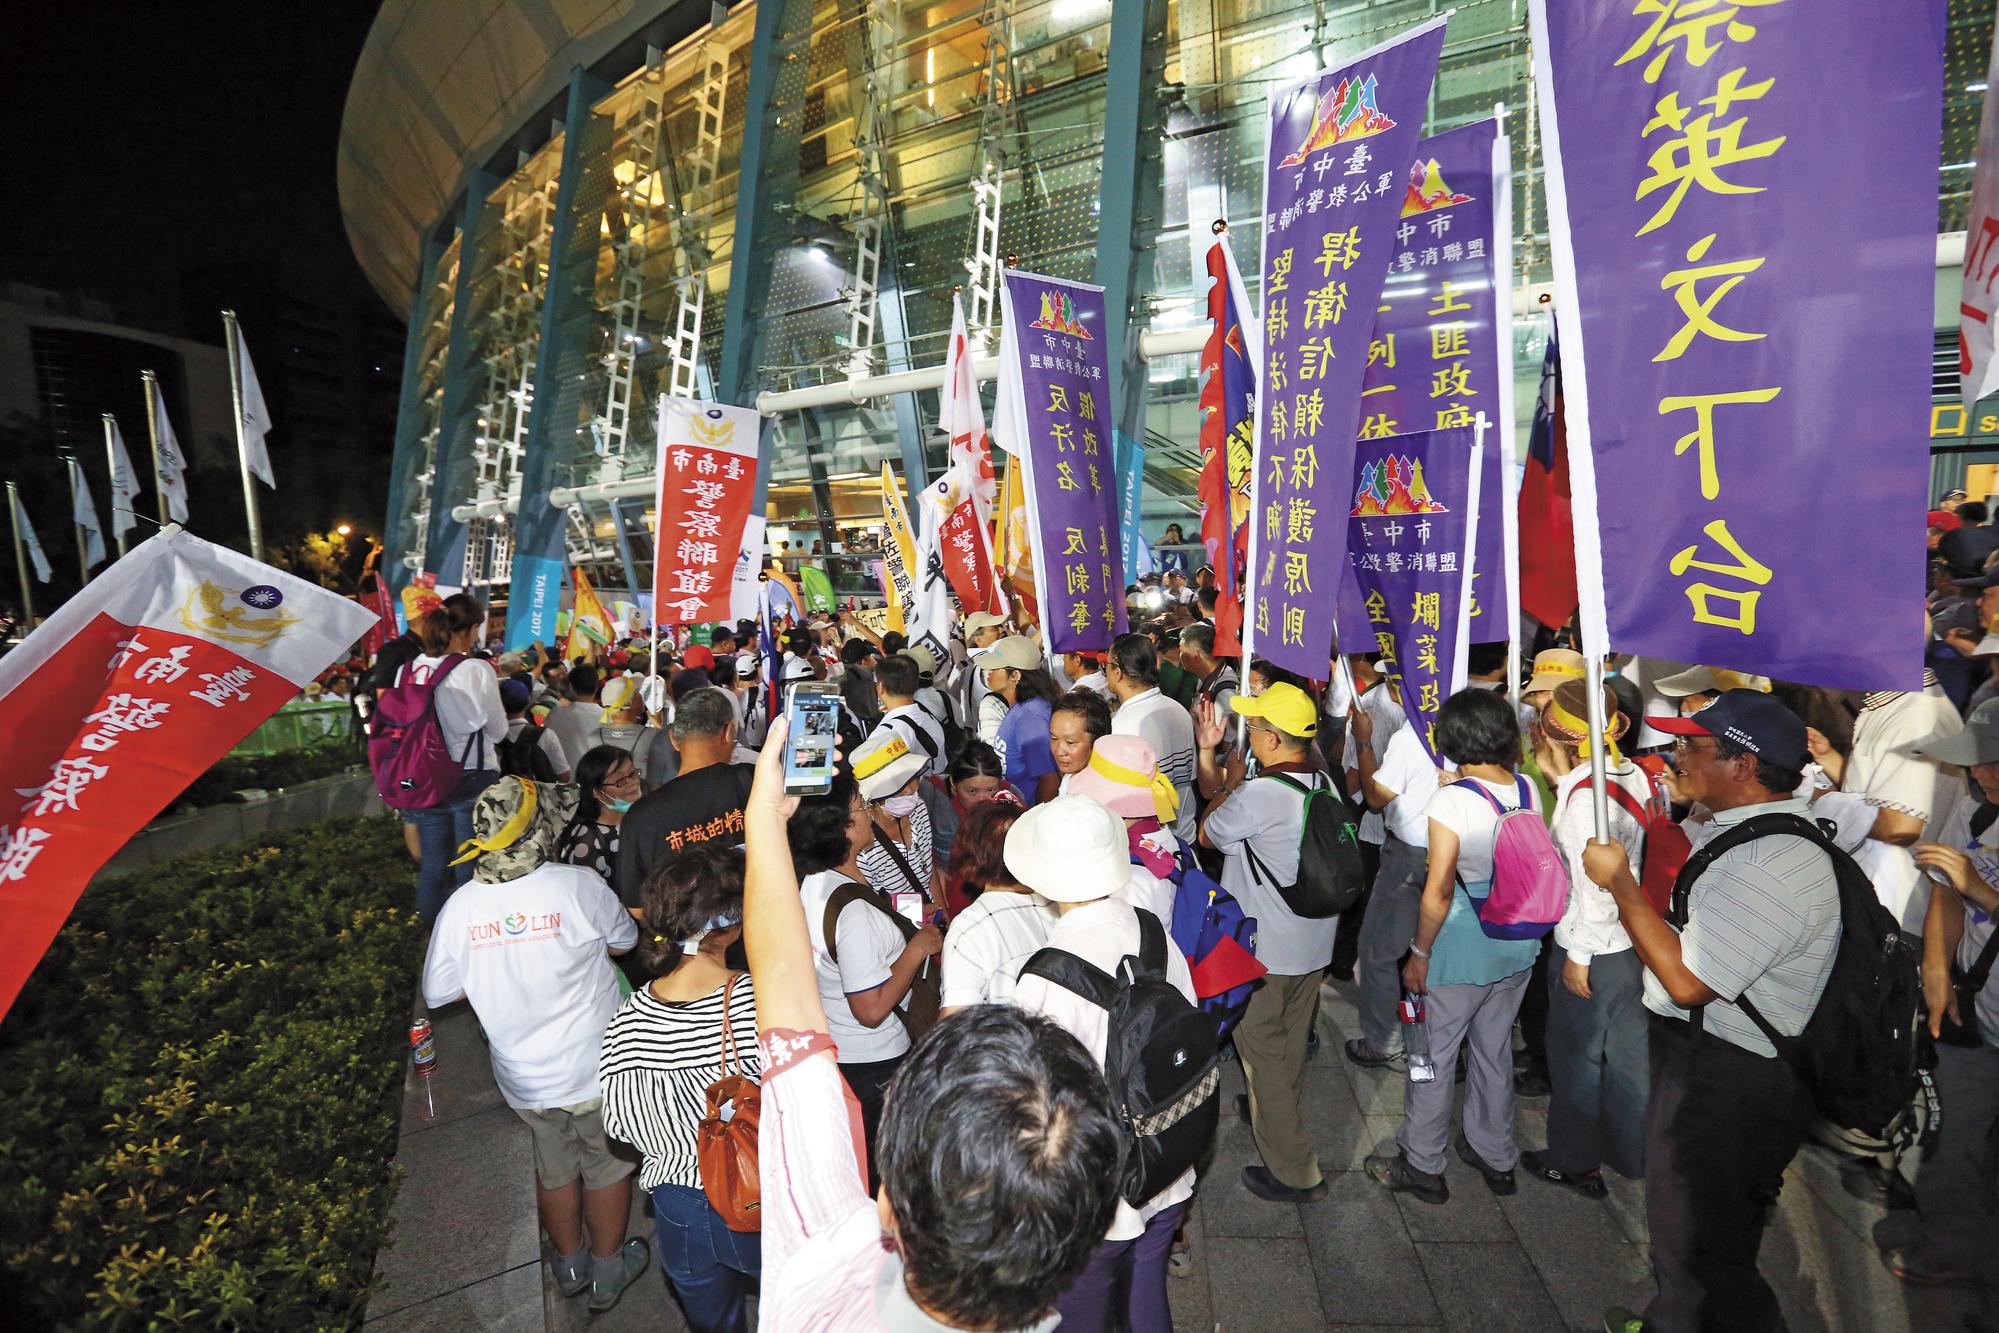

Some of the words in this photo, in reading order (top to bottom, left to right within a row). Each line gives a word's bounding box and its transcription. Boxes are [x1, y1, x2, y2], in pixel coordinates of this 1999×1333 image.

[1123, 469, 1135, 526] TAIPEI
[532, 574, 547, 611] TAIPEI
[531, 611, 543, 637] 2017
[467, 921, 502, 941] YUN
[531, 912, 560, 932] LIN
